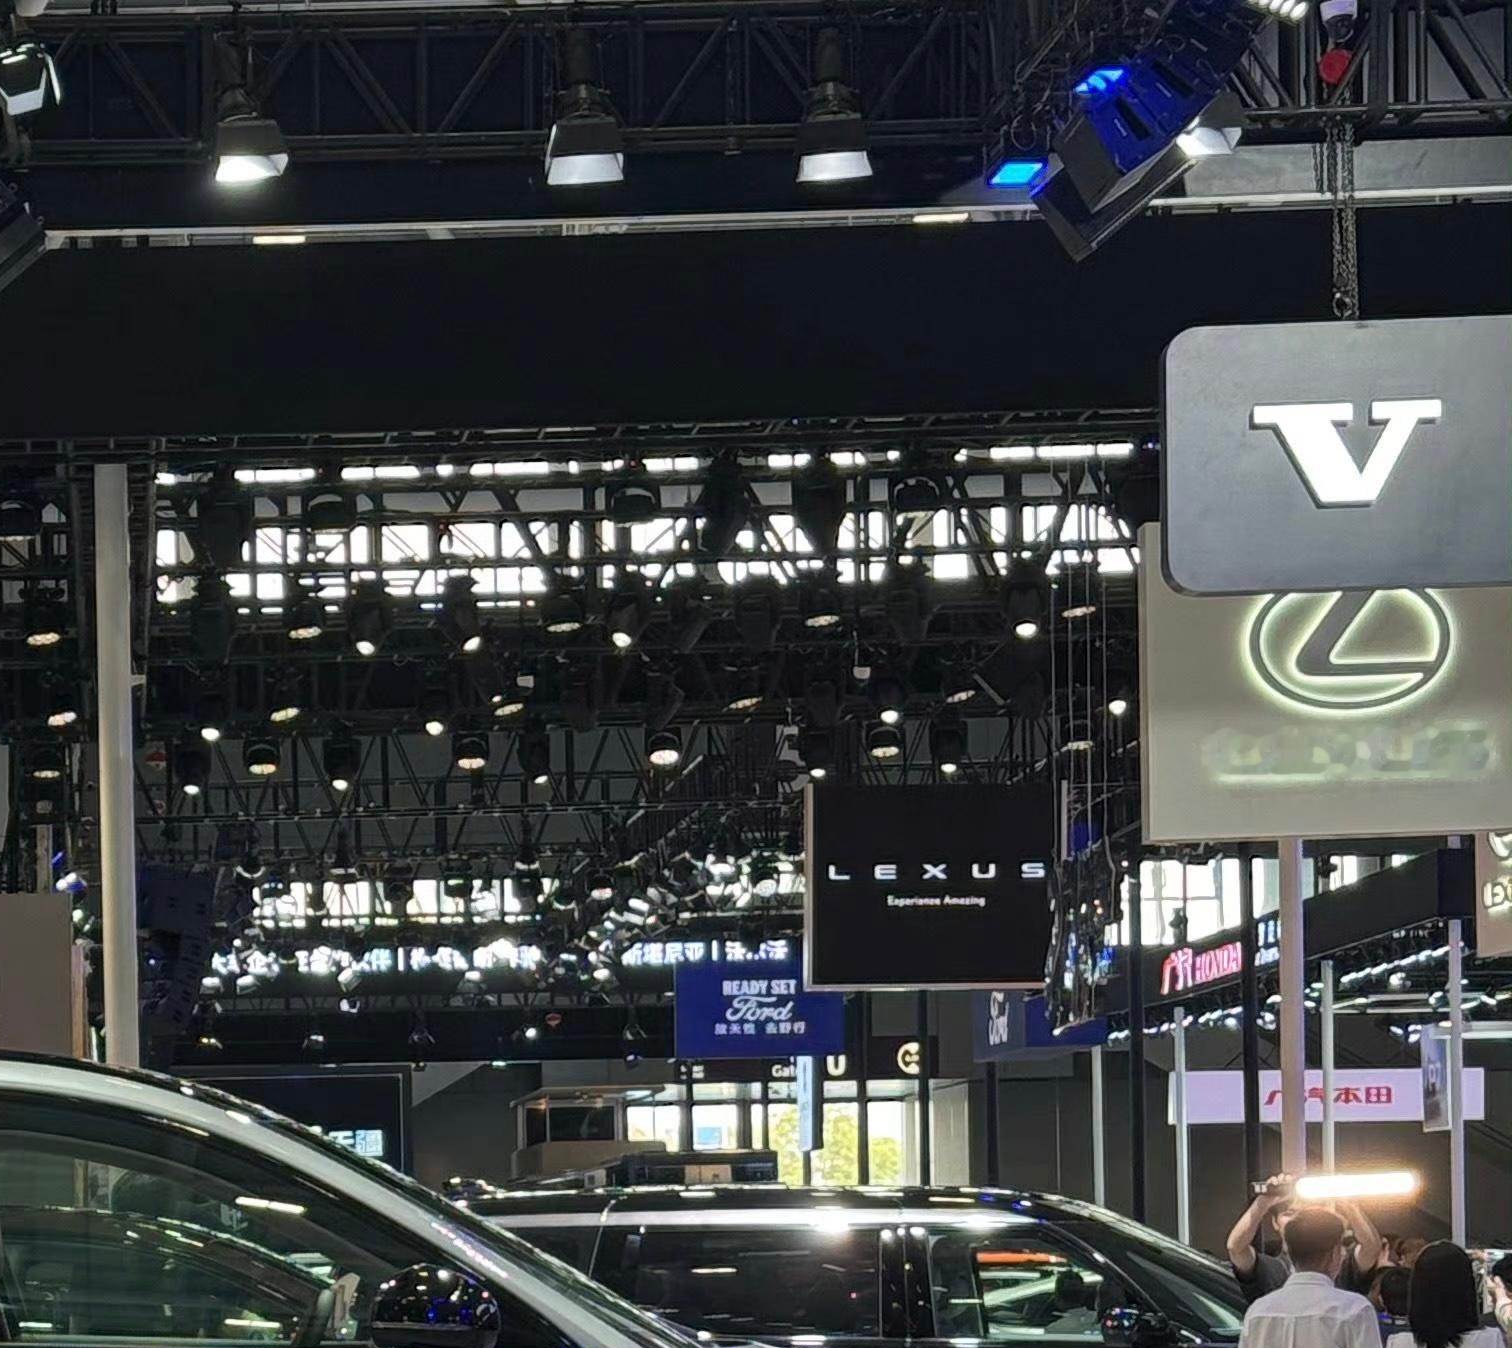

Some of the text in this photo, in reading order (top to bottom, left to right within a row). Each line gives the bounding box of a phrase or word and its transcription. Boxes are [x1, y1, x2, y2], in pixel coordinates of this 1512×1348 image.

[828, 863, 1047, 881] LEXUS
[887, 894, 986, 907] Experience Amazing
[722, 979, 797, 996] READY SET
[725, 995, 794, 1021] Ford
